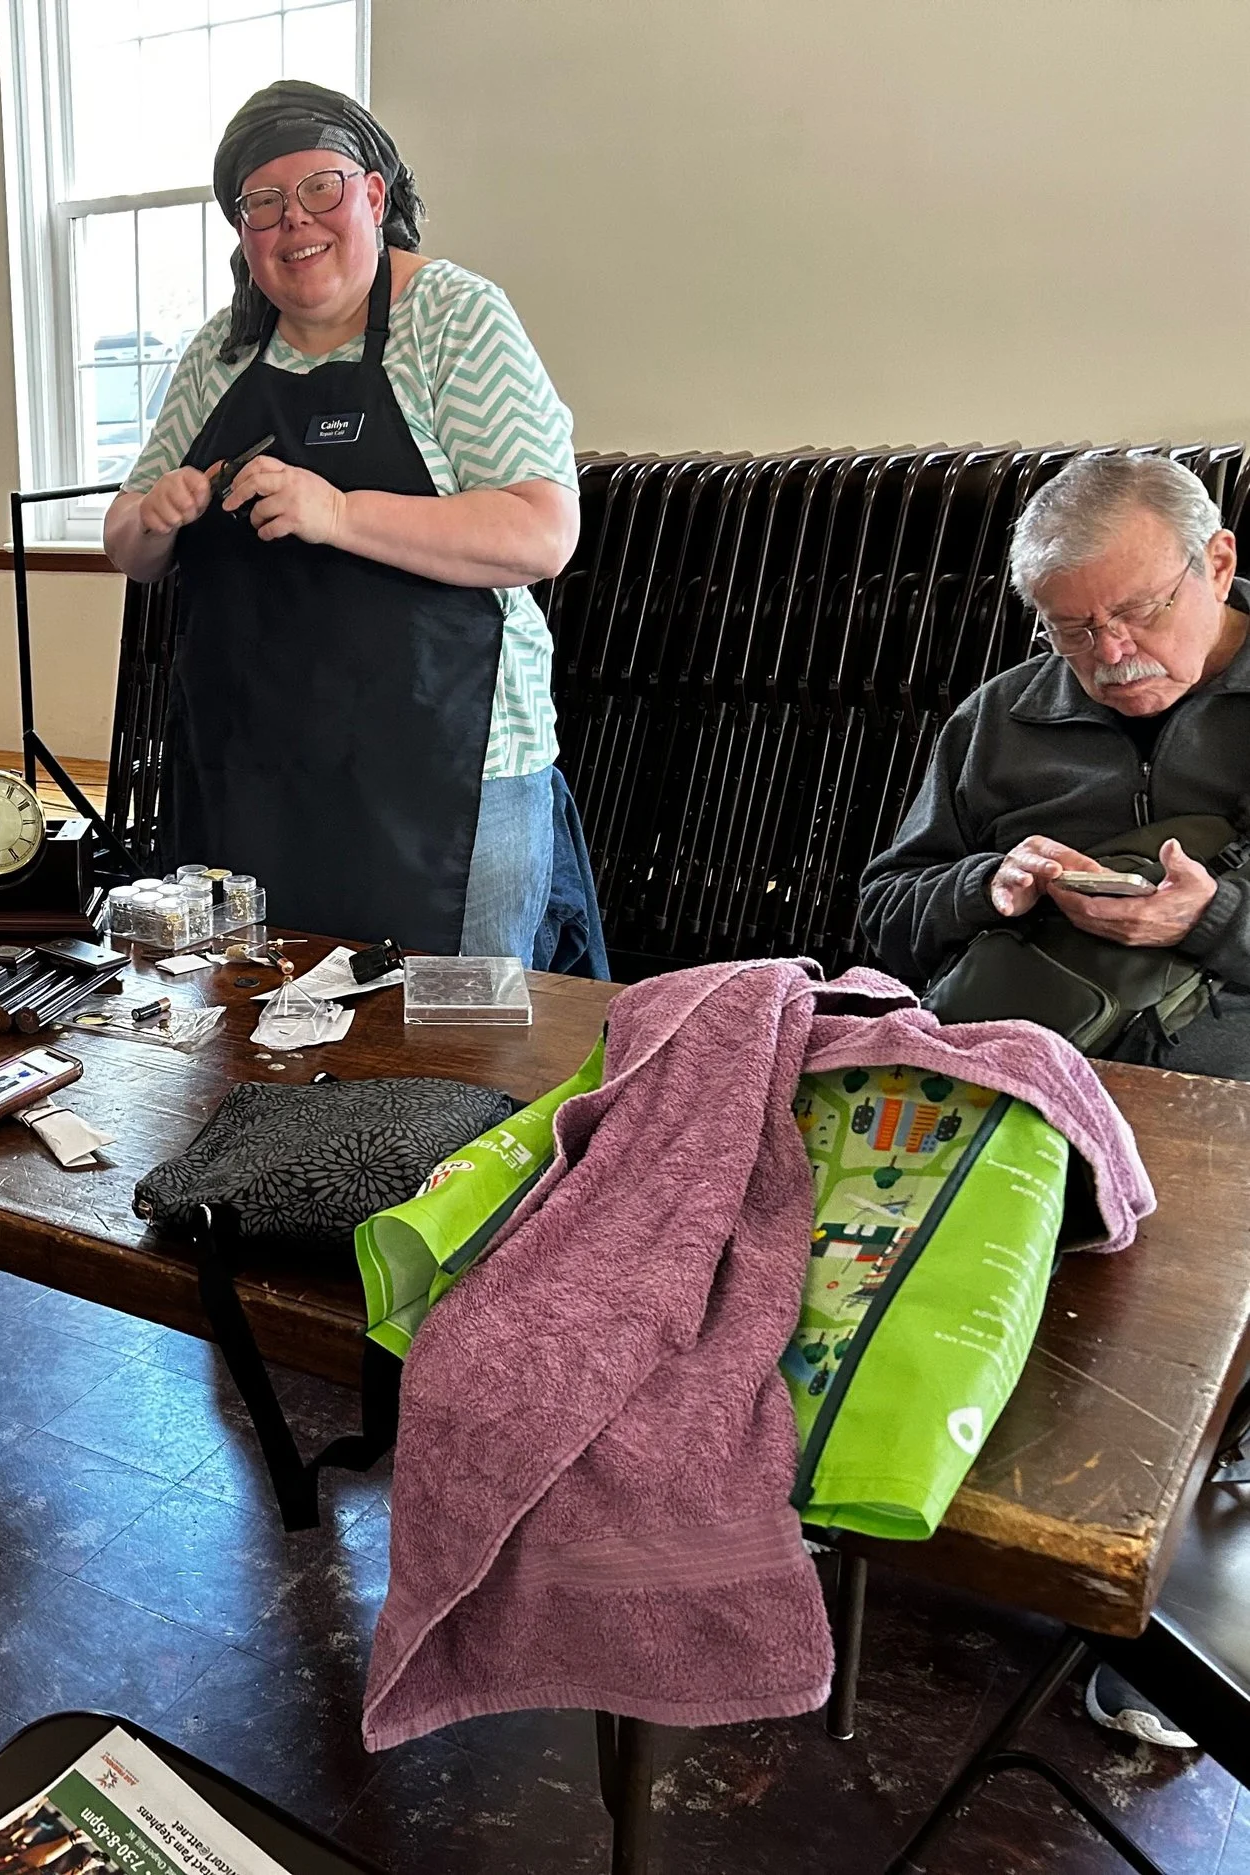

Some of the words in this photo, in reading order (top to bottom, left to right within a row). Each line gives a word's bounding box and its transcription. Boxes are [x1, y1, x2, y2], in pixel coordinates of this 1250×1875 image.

[320, 420, 349, 430] Caitlyn
[80, 1807, 146, 1872] 7:30-8:45pm
[136, 1805, 176, 1846] Stephens
[173, 1841, 195, 1863] Pam
